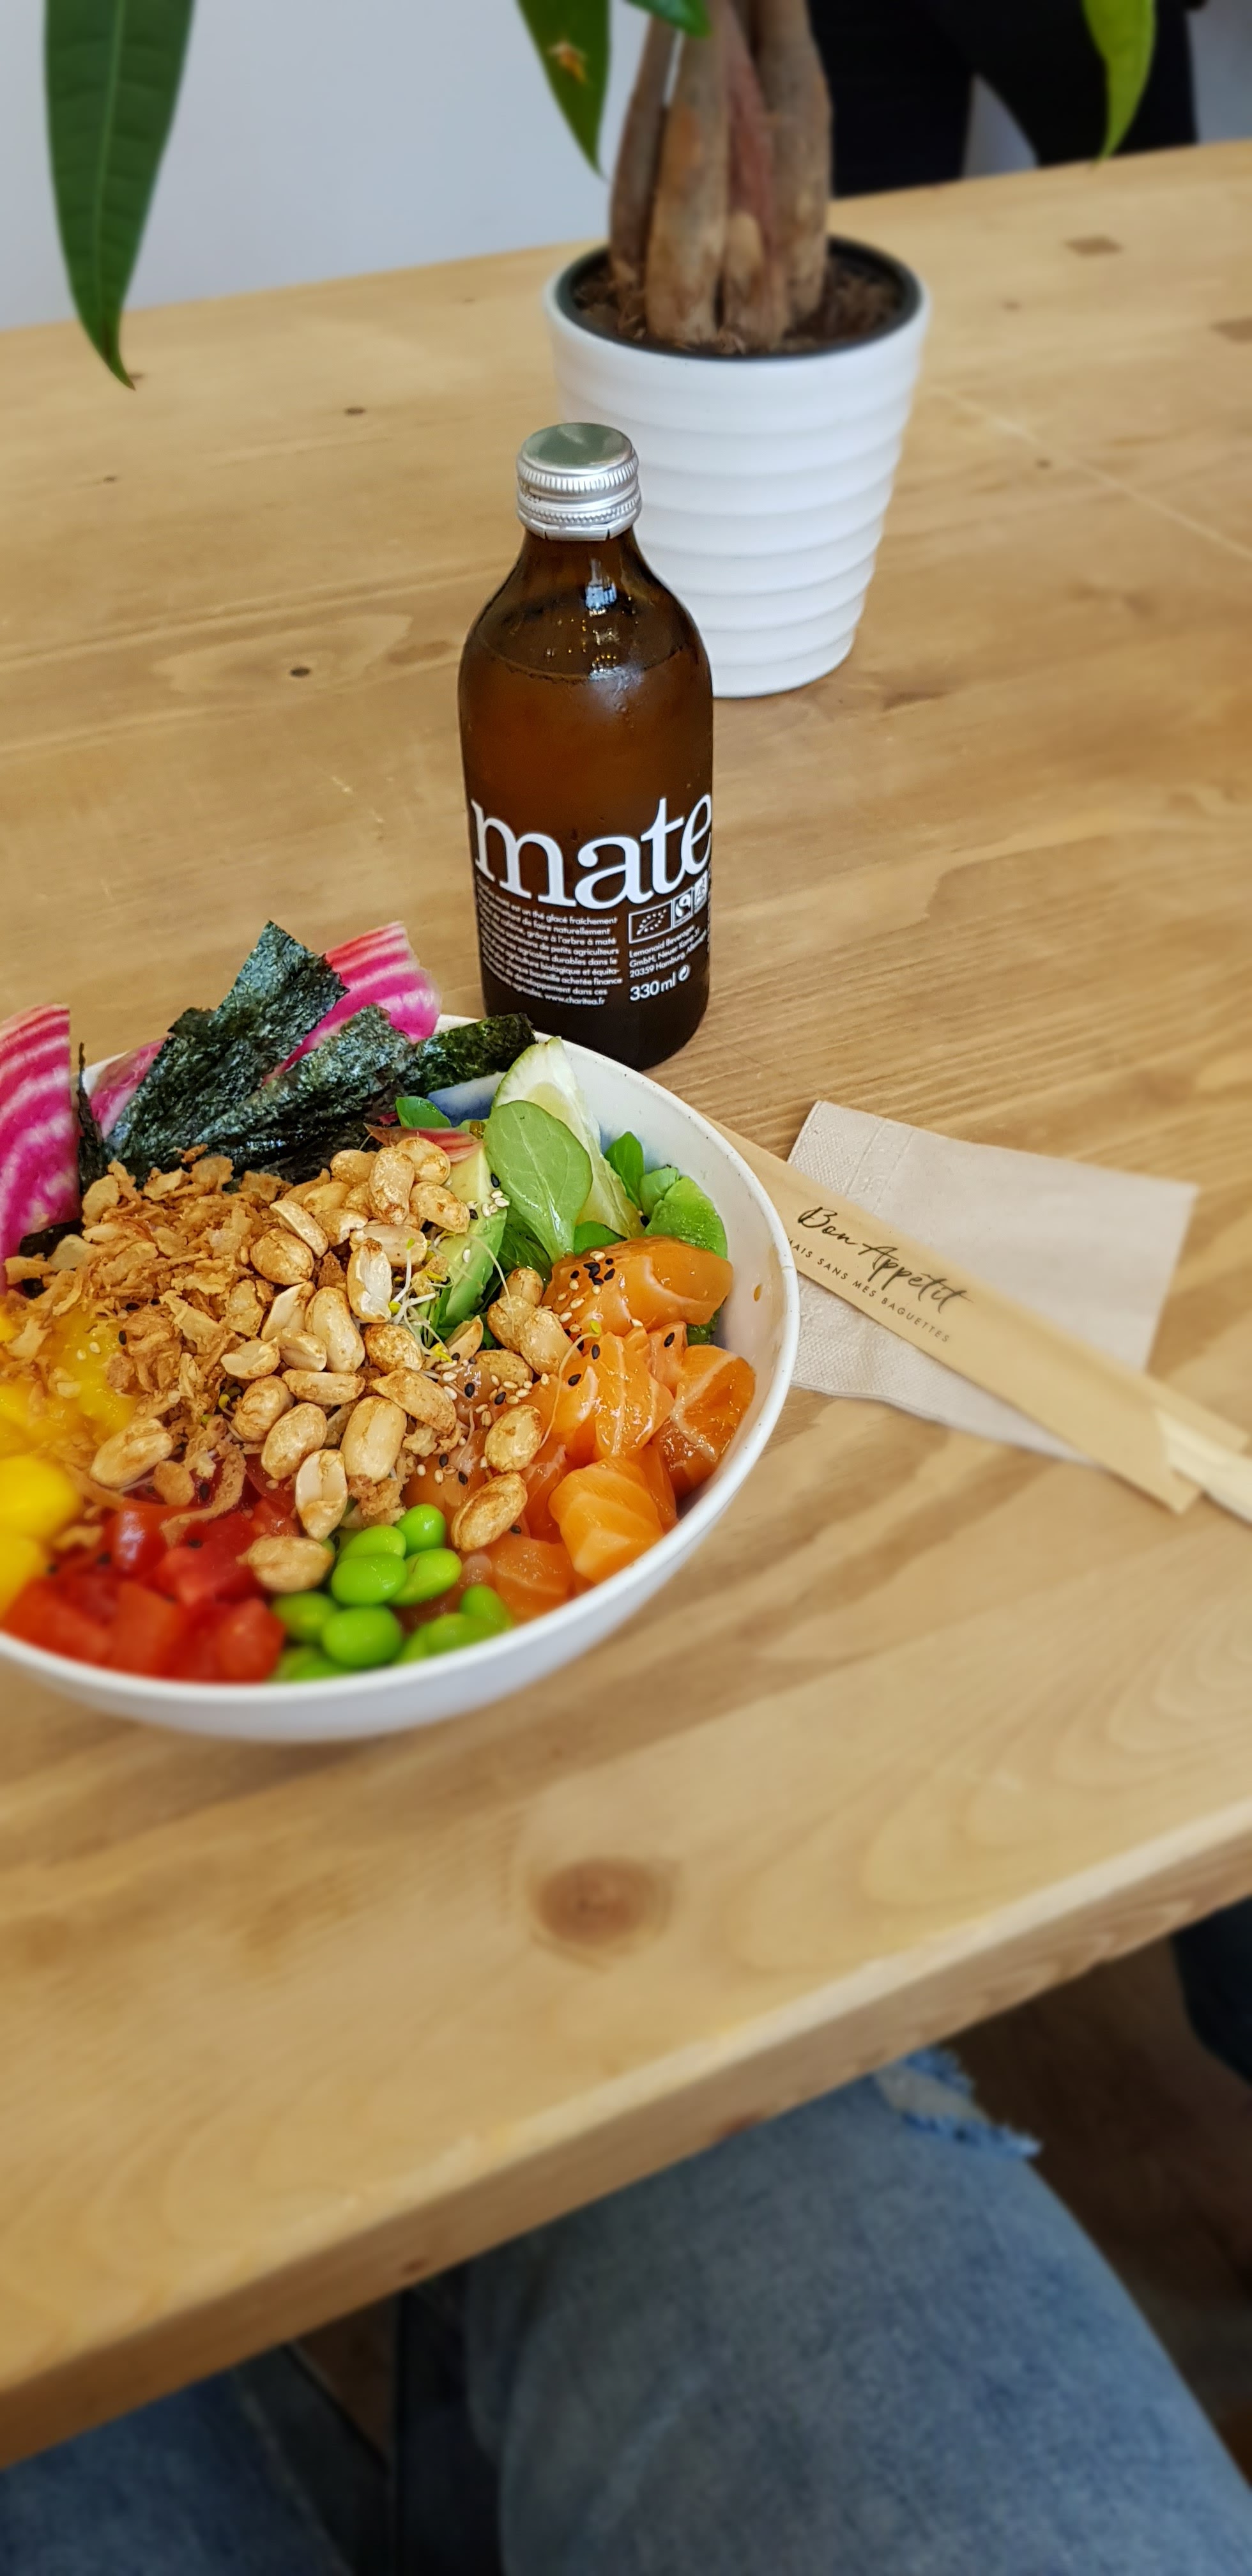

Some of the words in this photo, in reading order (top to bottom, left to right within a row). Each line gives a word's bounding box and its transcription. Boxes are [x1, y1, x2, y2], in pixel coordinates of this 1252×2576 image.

[471, 793, 712, 910] mate
[546, 914, 568, 924] glacé
[533, 920, 552, 931] faire
[553, 926, 611, 935] naturellement
[526, 931, 549, 942] grâce
[586, 937, 594, 946] à
[595, 937, 616, 946] maté
[551, 947, 572, 955] petits
[572, 947, 620, 957] agriculteurs
[629, 940, 665, 959] Lemonaid
[551, 955, 586, 966] durables
[587, 958, 608, 966] dans
[609, 957, 618, 965] le
[540, 961, 581, 976] biologique
[629, 965, 655, 979] 20359
[561, 976, 593, 986] achetée
[593, 977, 623, 986] finance
[572, 987, 593, 995] dans
[544, 993, 606, 1006] www.charitea.fr
[816, 1257, 849, 1280] SANS
[851, 1280, 877, 1298] MES
[880, 1297, 950, 1343] BAGUETTES
